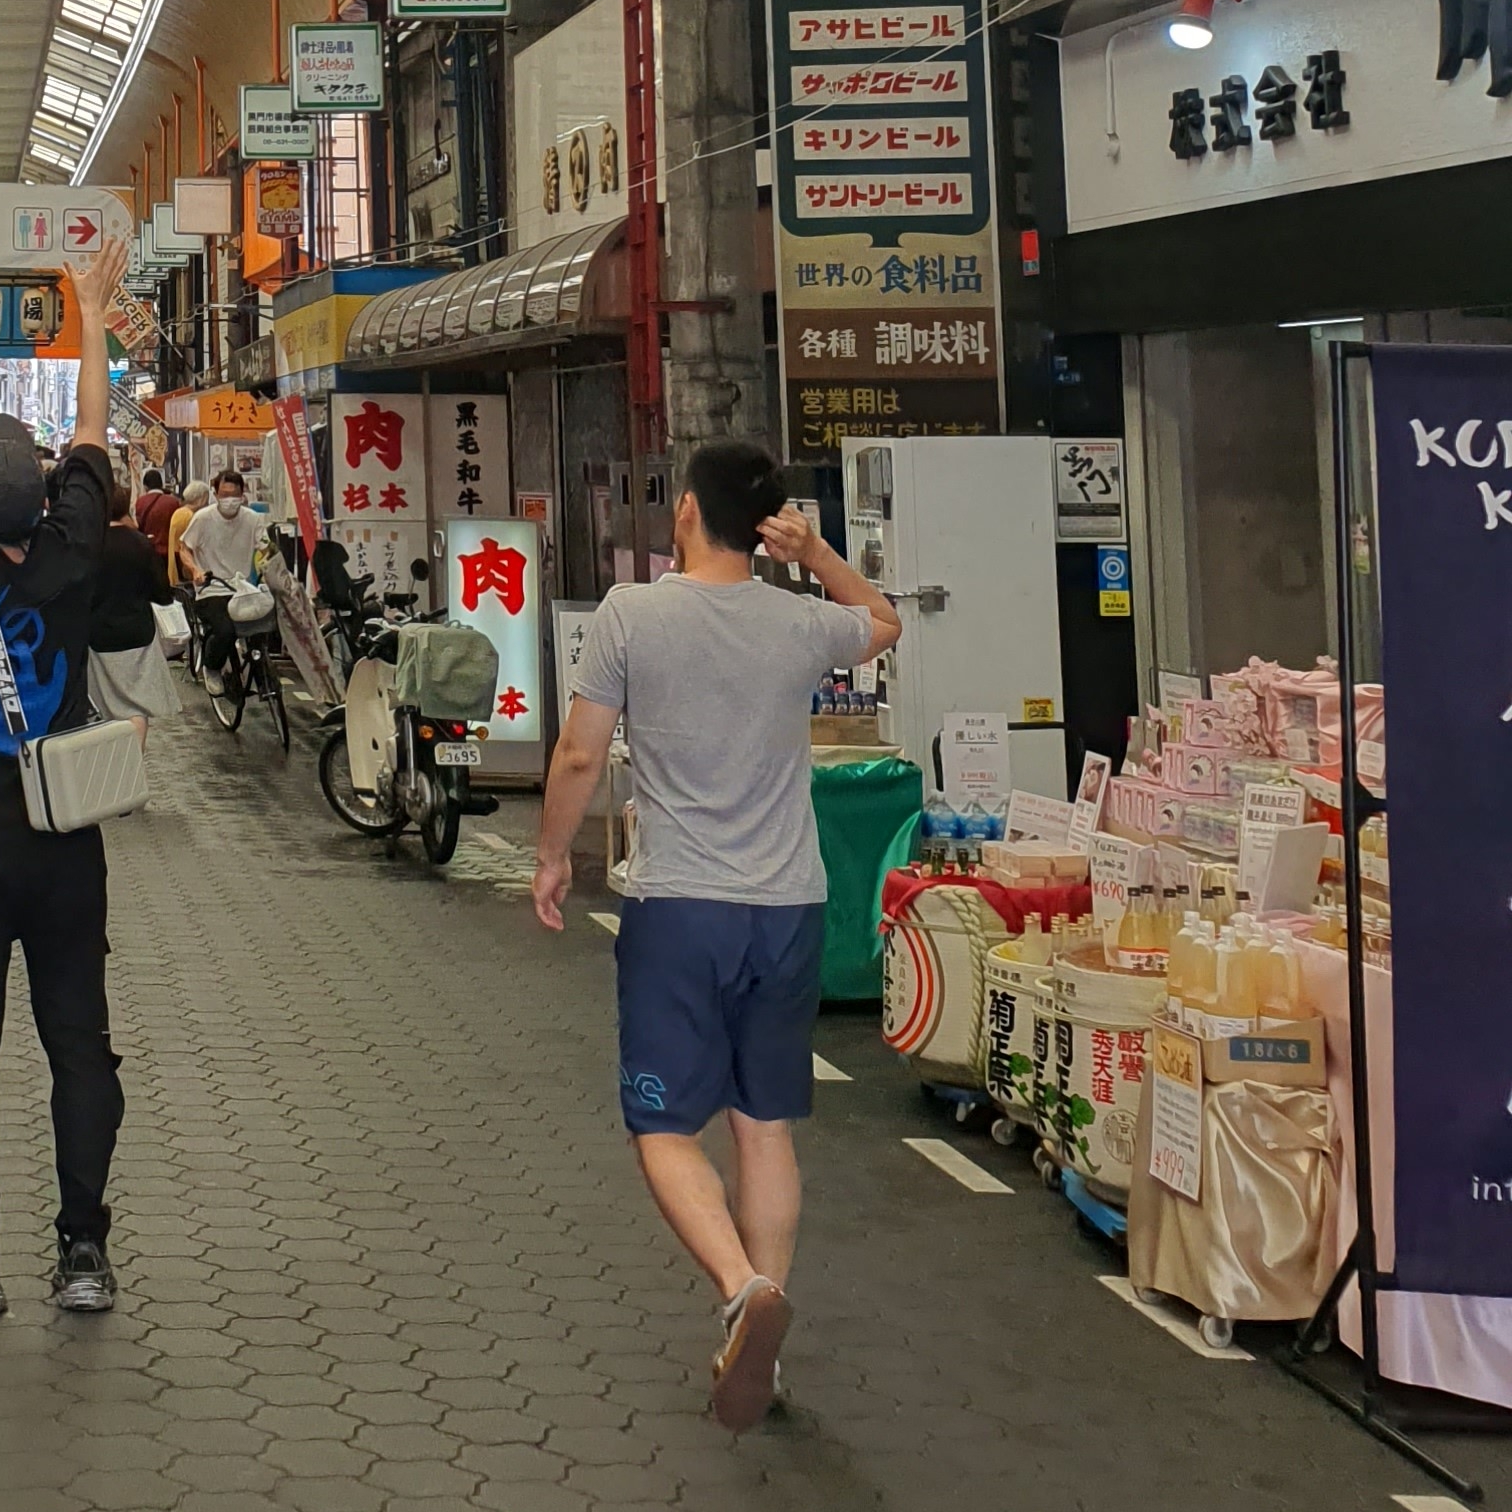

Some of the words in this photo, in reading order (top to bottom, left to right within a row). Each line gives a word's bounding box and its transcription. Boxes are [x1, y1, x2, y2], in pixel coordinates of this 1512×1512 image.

[799, 14, 955, 42] アサヒビール
[306, 74, 349, 82] クリーニング
[801, 70, 958, 96] サッポロビール
[803, 125, 960, 152] キリンビール
[805, 182, 963, 208] サントリービール
[260, 214, 300, 223] STAMP
[794, 254, 983, 295] 世界の食料品
[798, 328, 858, 359] 各種
[873, 320, 990, 366] 調味料
[800, 388, 902, 415] 営業用は
[343, 401, 405, 471] 肉
[455, 402, 483, 515] 黒毛和牛
[342, 482, 409, 514] 杉本
[457, 537, 527, 616] 肉
